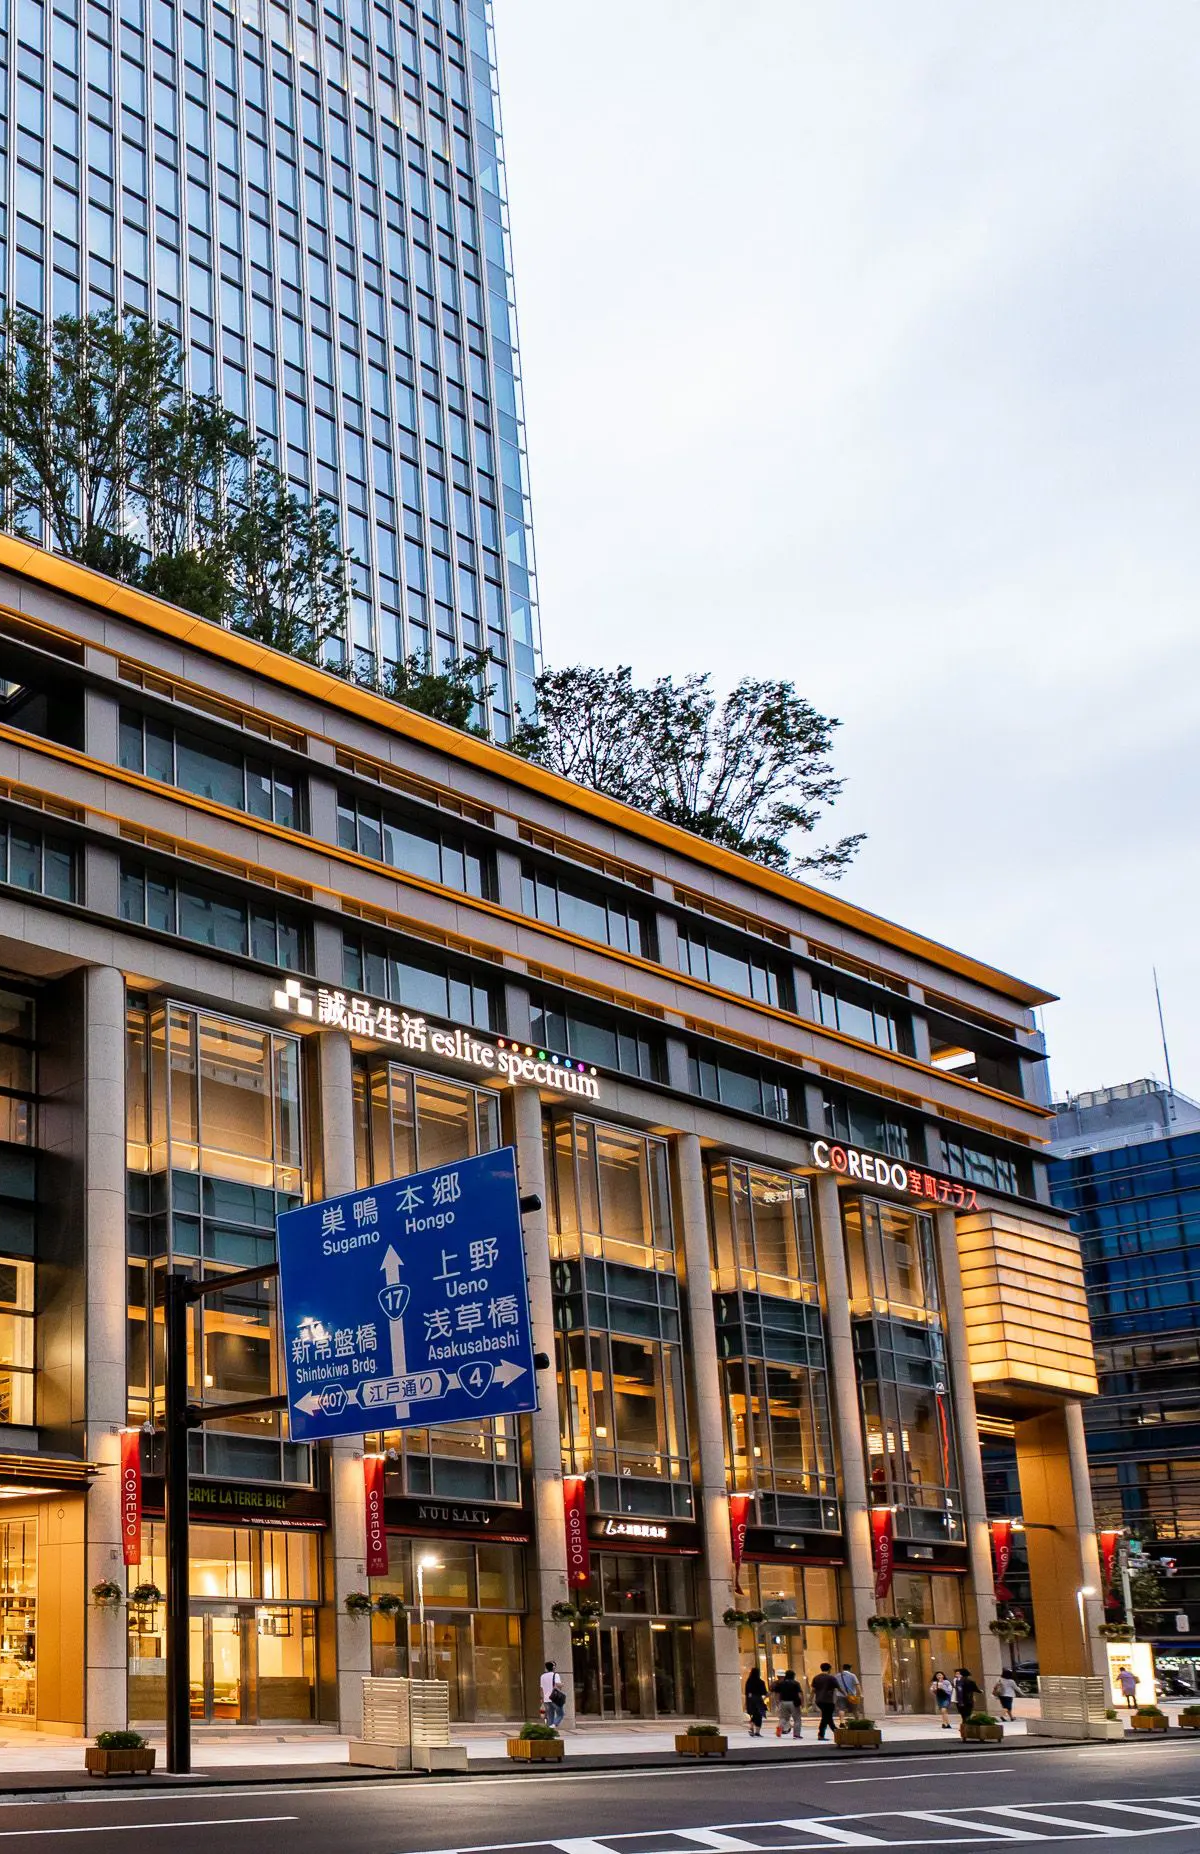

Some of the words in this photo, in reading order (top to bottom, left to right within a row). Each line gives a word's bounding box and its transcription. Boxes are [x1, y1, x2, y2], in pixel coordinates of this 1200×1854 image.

[318, 988, 428, 1052] 誠品生活
[431, 1030, 495, 1068] eslite
[497, 1051, 601, 1100] spectrum
[813, 1140, 908, 1191] COREDO
[908, 1169, 981, 1211] 室町テラス
[396, 1172, 462, 1215] 本郷
[321, 1196, 379, 1237] 巣鴨
[404, 1210, 456, 1235] Hongo
[323, 1230, 380, 1256] Sugamo
[432, 1237, 499, 1281] 上野
[385, 1290, 402, 1311] 17
[445, 1277, 489, 1298] Ueno
[422, 1294, 519, 1342] 浅草橋
[428, 1330, 520, 1361] Asakusabashi
[296, 1364, 350, 1384] Shintokiwa
[352, 1358, 378, 1376] Brdg.
[468, 1367, 483, 1387] 4
[321, 1390, 343, 1408] 407
[369, 1379, 433, 1404] 江戸通り
[124, 1468, 137, 1536] COREDO
[188, 1487, 217, 1503] ERME
[220, 1490, 232, 1505] LA
[233, 1491, 263, 1507] TERRE
[369, 1490, 382, 1551] COREDO
[418, 1505, 490, 1524] NOUSAKU
[569, 1508, 583, 1564] COREDO
